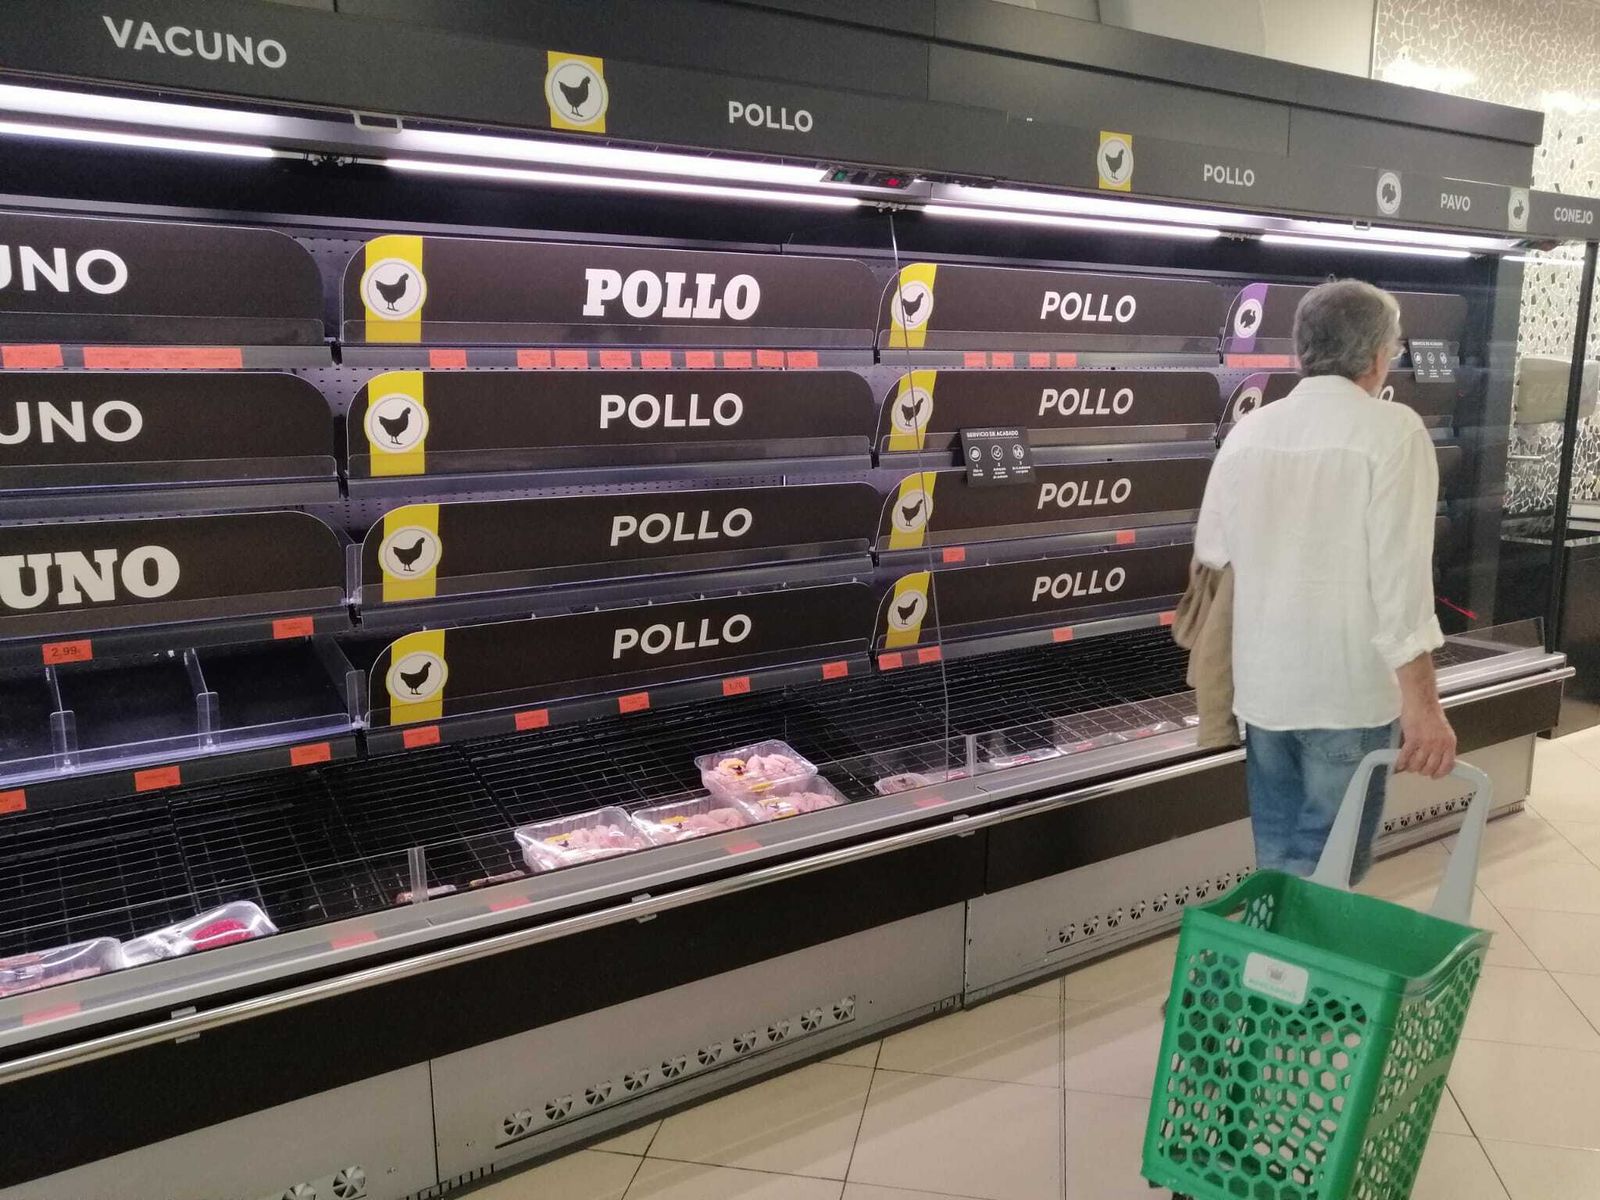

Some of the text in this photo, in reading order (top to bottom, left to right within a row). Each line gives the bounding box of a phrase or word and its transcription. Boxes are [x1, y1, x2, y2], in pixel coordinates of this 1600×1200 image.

[103, 15, 287, 69] VACUNO
[728, 100, 813, 133] POLLO
[1203, 164, 1255, 187] POLLO
[1440, 193, 1471, 212] PAVO
[1553, 207, 1594, 225] CONEJO
[0, 244, 128, 295] NO
[582, 268, 761, 321] POLLO
[1040, 290, 1137, 323] POLLO
[599, 392, 744, 429] POLLO
[1038, 387, 1134, 416] POLLO
[1037, 477, 1132, 510] POLLO
[610, 507, 753, 547] POLLO
[0, 545, 180, 609] UNO
[1031, 567, 1126, 602] POLLO
[612, 613, 752, 660] POLLO
